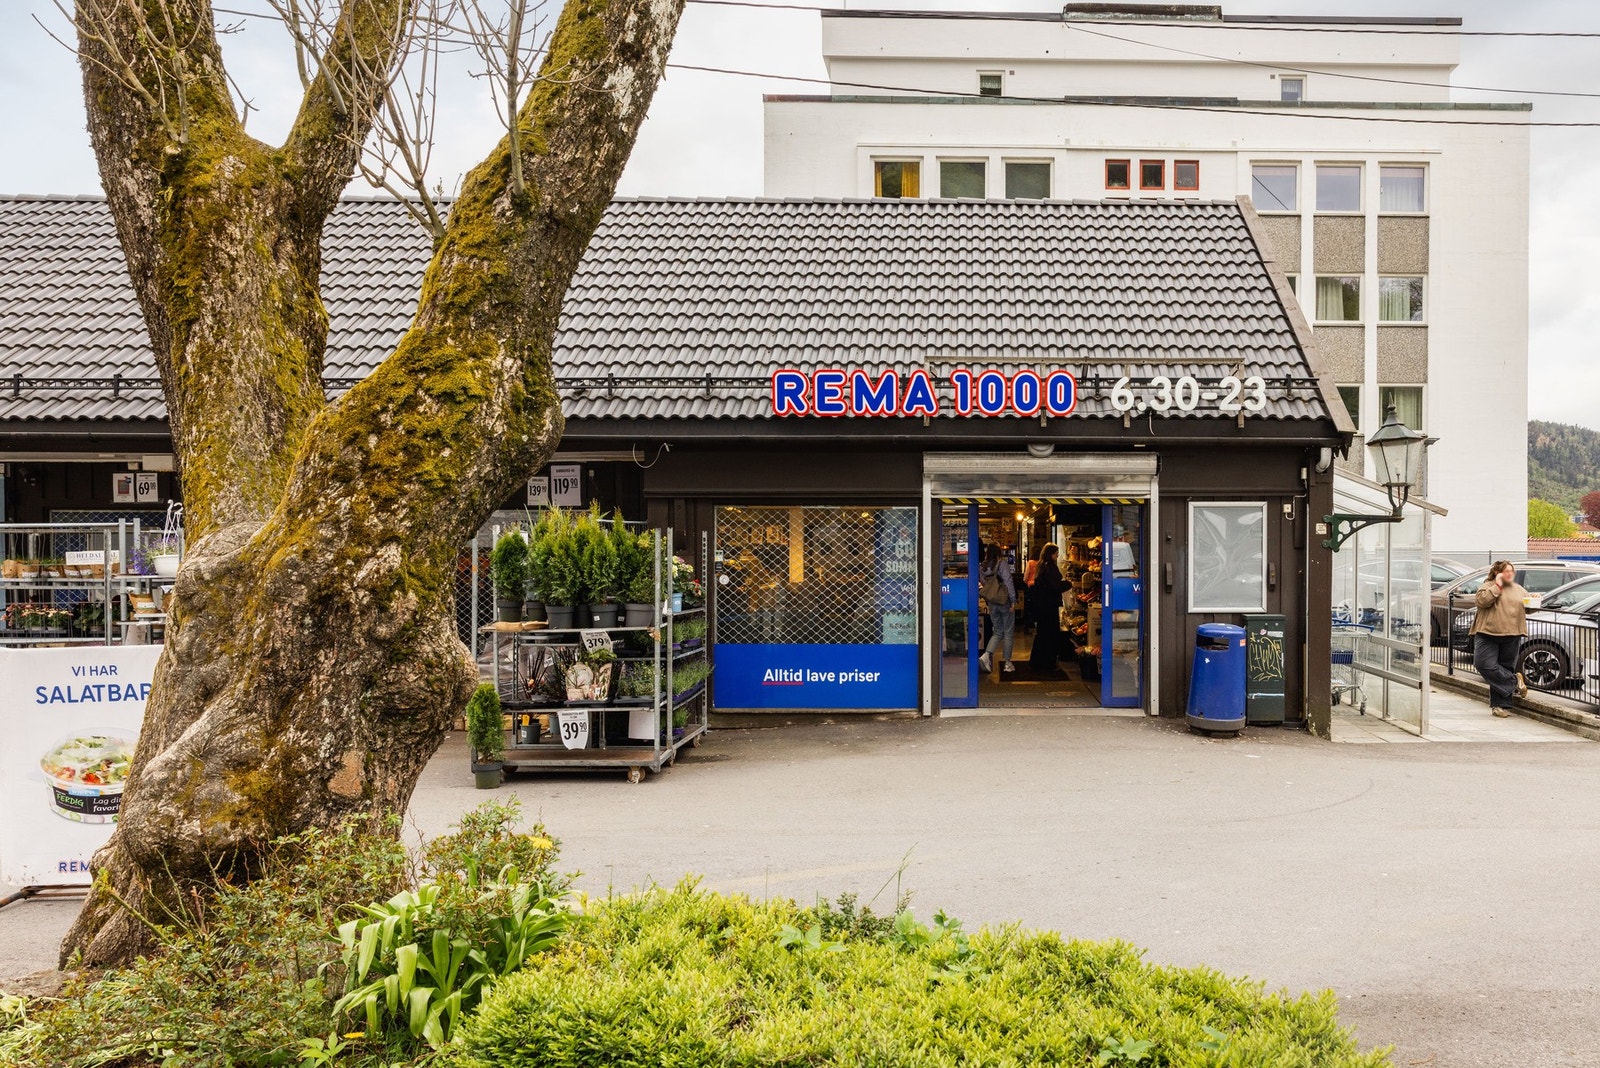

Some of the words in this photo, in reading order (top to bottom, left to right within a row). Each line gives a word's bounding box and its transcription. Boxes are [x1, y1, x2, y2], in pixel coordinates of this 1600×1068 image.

[772, 369, 939, 417] REMA
[951, 369, 1077, 417] 1000
[1111, 375, 1267, 411] 6.30-23
[554, 478, 569, 494] 119
[586, 637, 604, 649] 379
[72, 666, 85, 677] VI
[89, 665, 118, 676] HAR
[763, 669, 802, 682] Alltid
[806, 669, 836, 682] lave
[840, 669, 880, 684] priser
[36, 683, 152, 704] SALATBAR
[562, 722, 579, 740] 39
[93, 797, 109, 805] Lag
[93, 803, 119, 812] favori
[58, 861, 91, 872] REM
